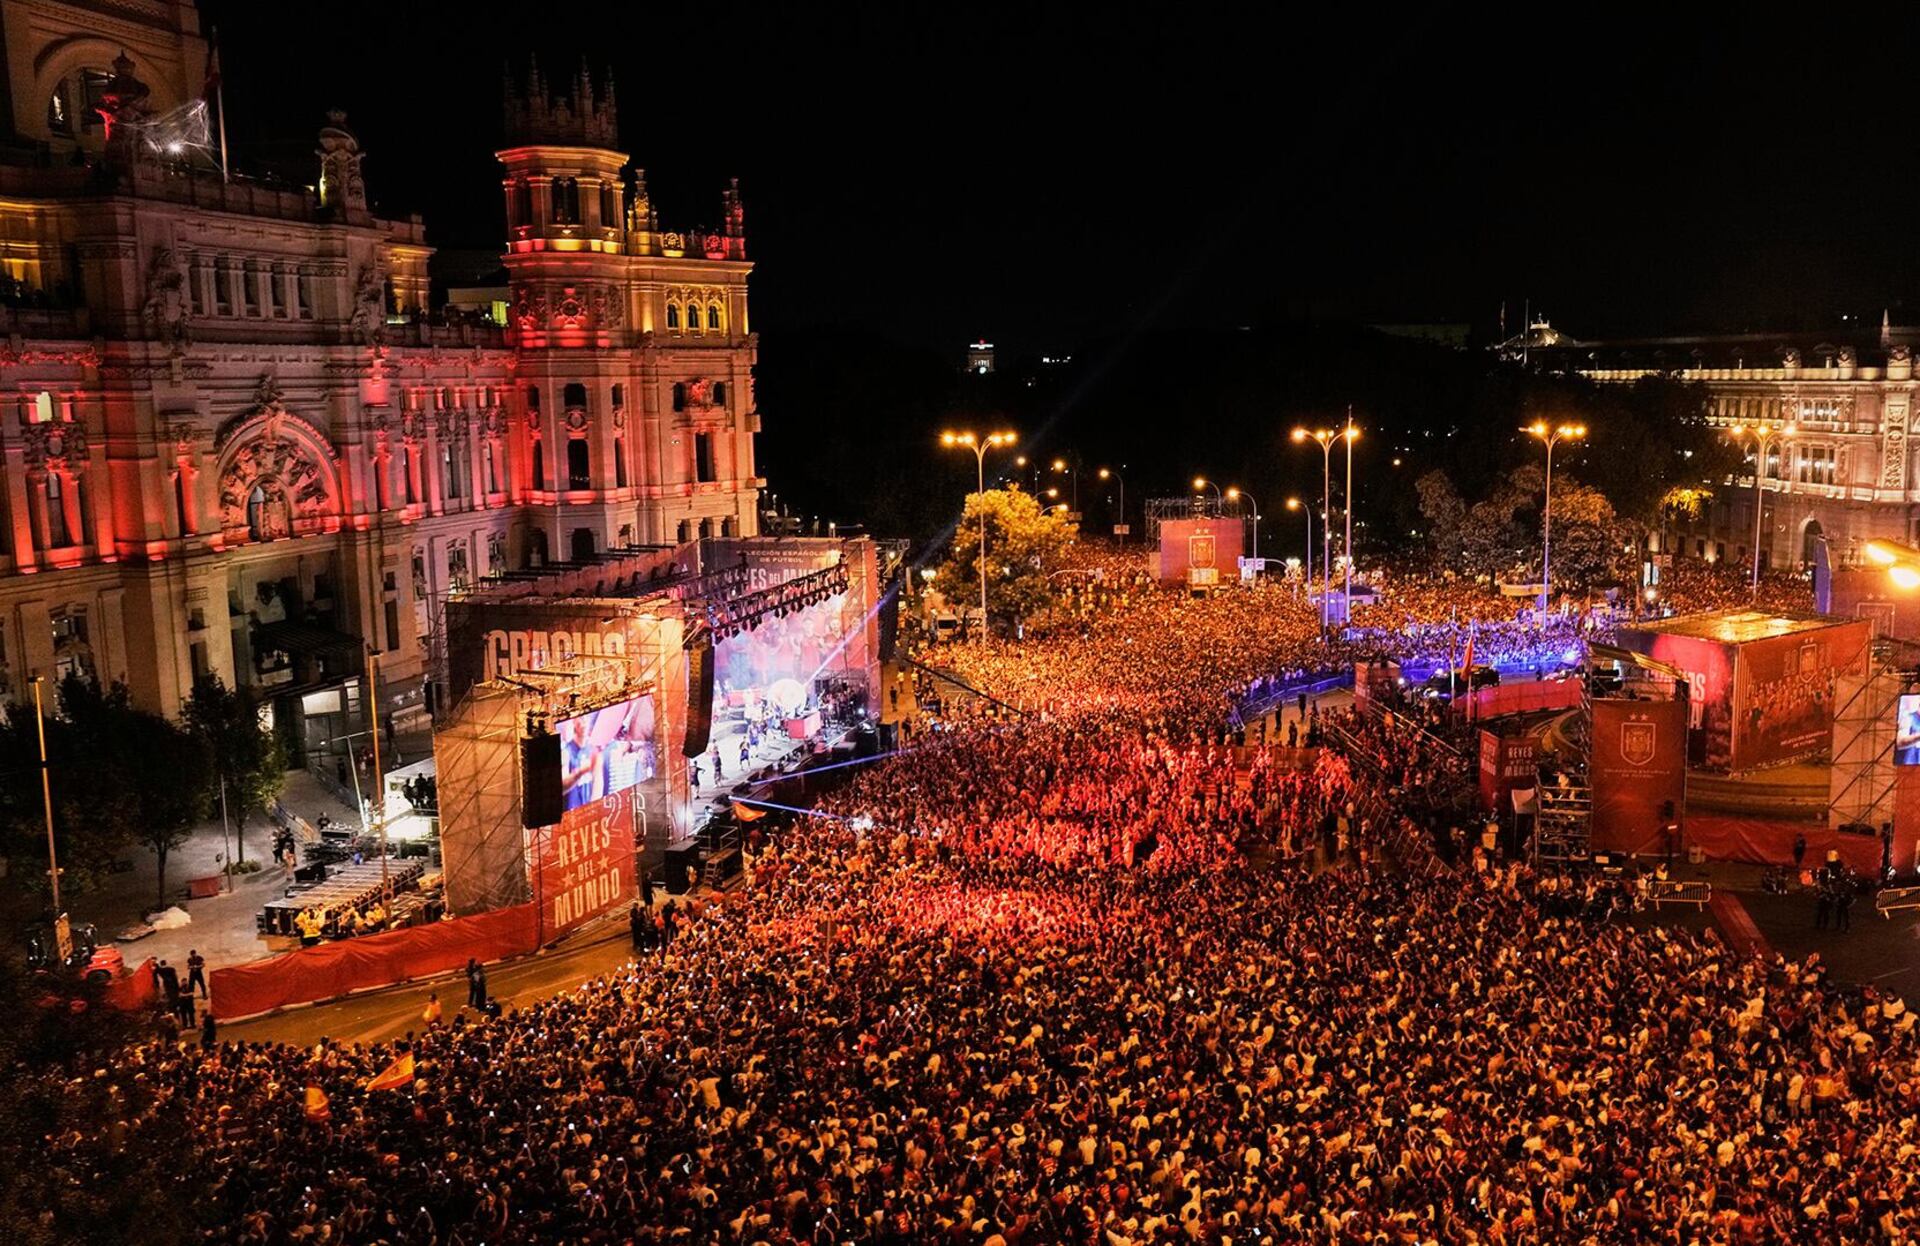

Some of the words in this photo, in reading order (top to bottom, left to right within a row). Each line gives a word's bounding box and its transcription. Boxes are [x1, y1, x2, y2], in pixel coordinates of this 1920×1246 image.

[558, 816, 610, 868] REYES
[577, 858, 595, 881] DEL
[554, 867, 621, 929] MUNDO
